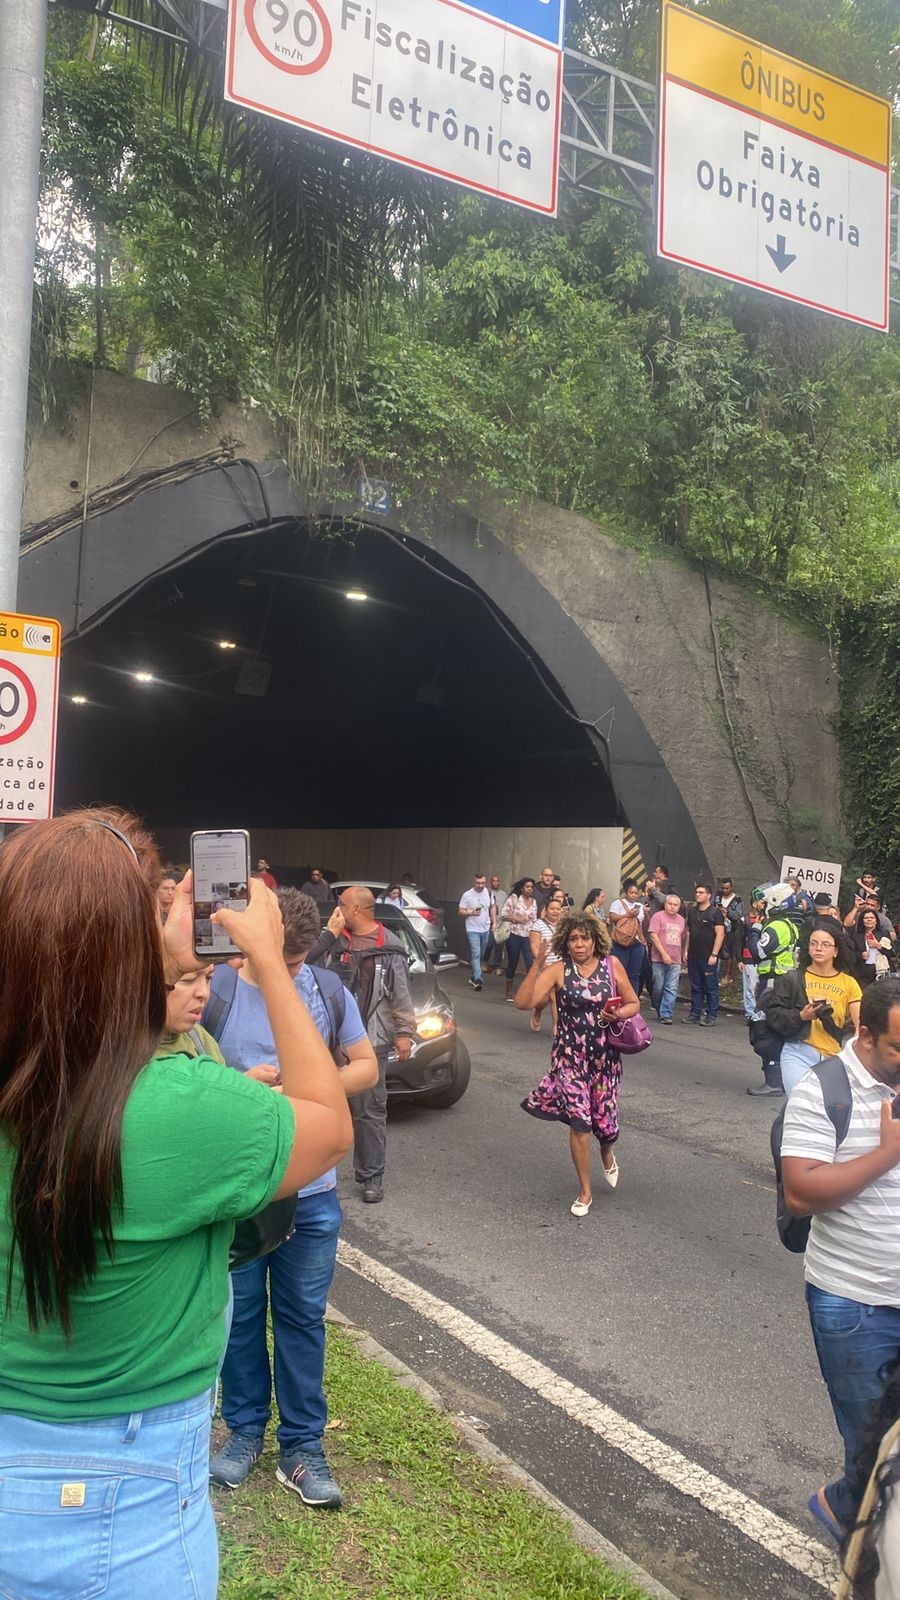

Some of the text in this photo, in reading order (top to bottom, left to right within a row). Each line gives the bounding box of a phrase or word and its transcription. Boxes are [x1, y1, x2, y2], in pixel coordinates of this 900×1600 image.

[266, 0, 317, 47] 90
[274, 42, 303, 61] km/h
[341, 0, 550, 112] Fiscalização
[740, 51, 825, 122] ÔNIBUS
[351, 73, 532, 171] Eletrônica
[743, 130, 821, 189] Faixa
[697, 159, 860, 248] Obrigatória
[28, 779, 46, 790] de
[787, 866, 835, 884] FARÓIS
